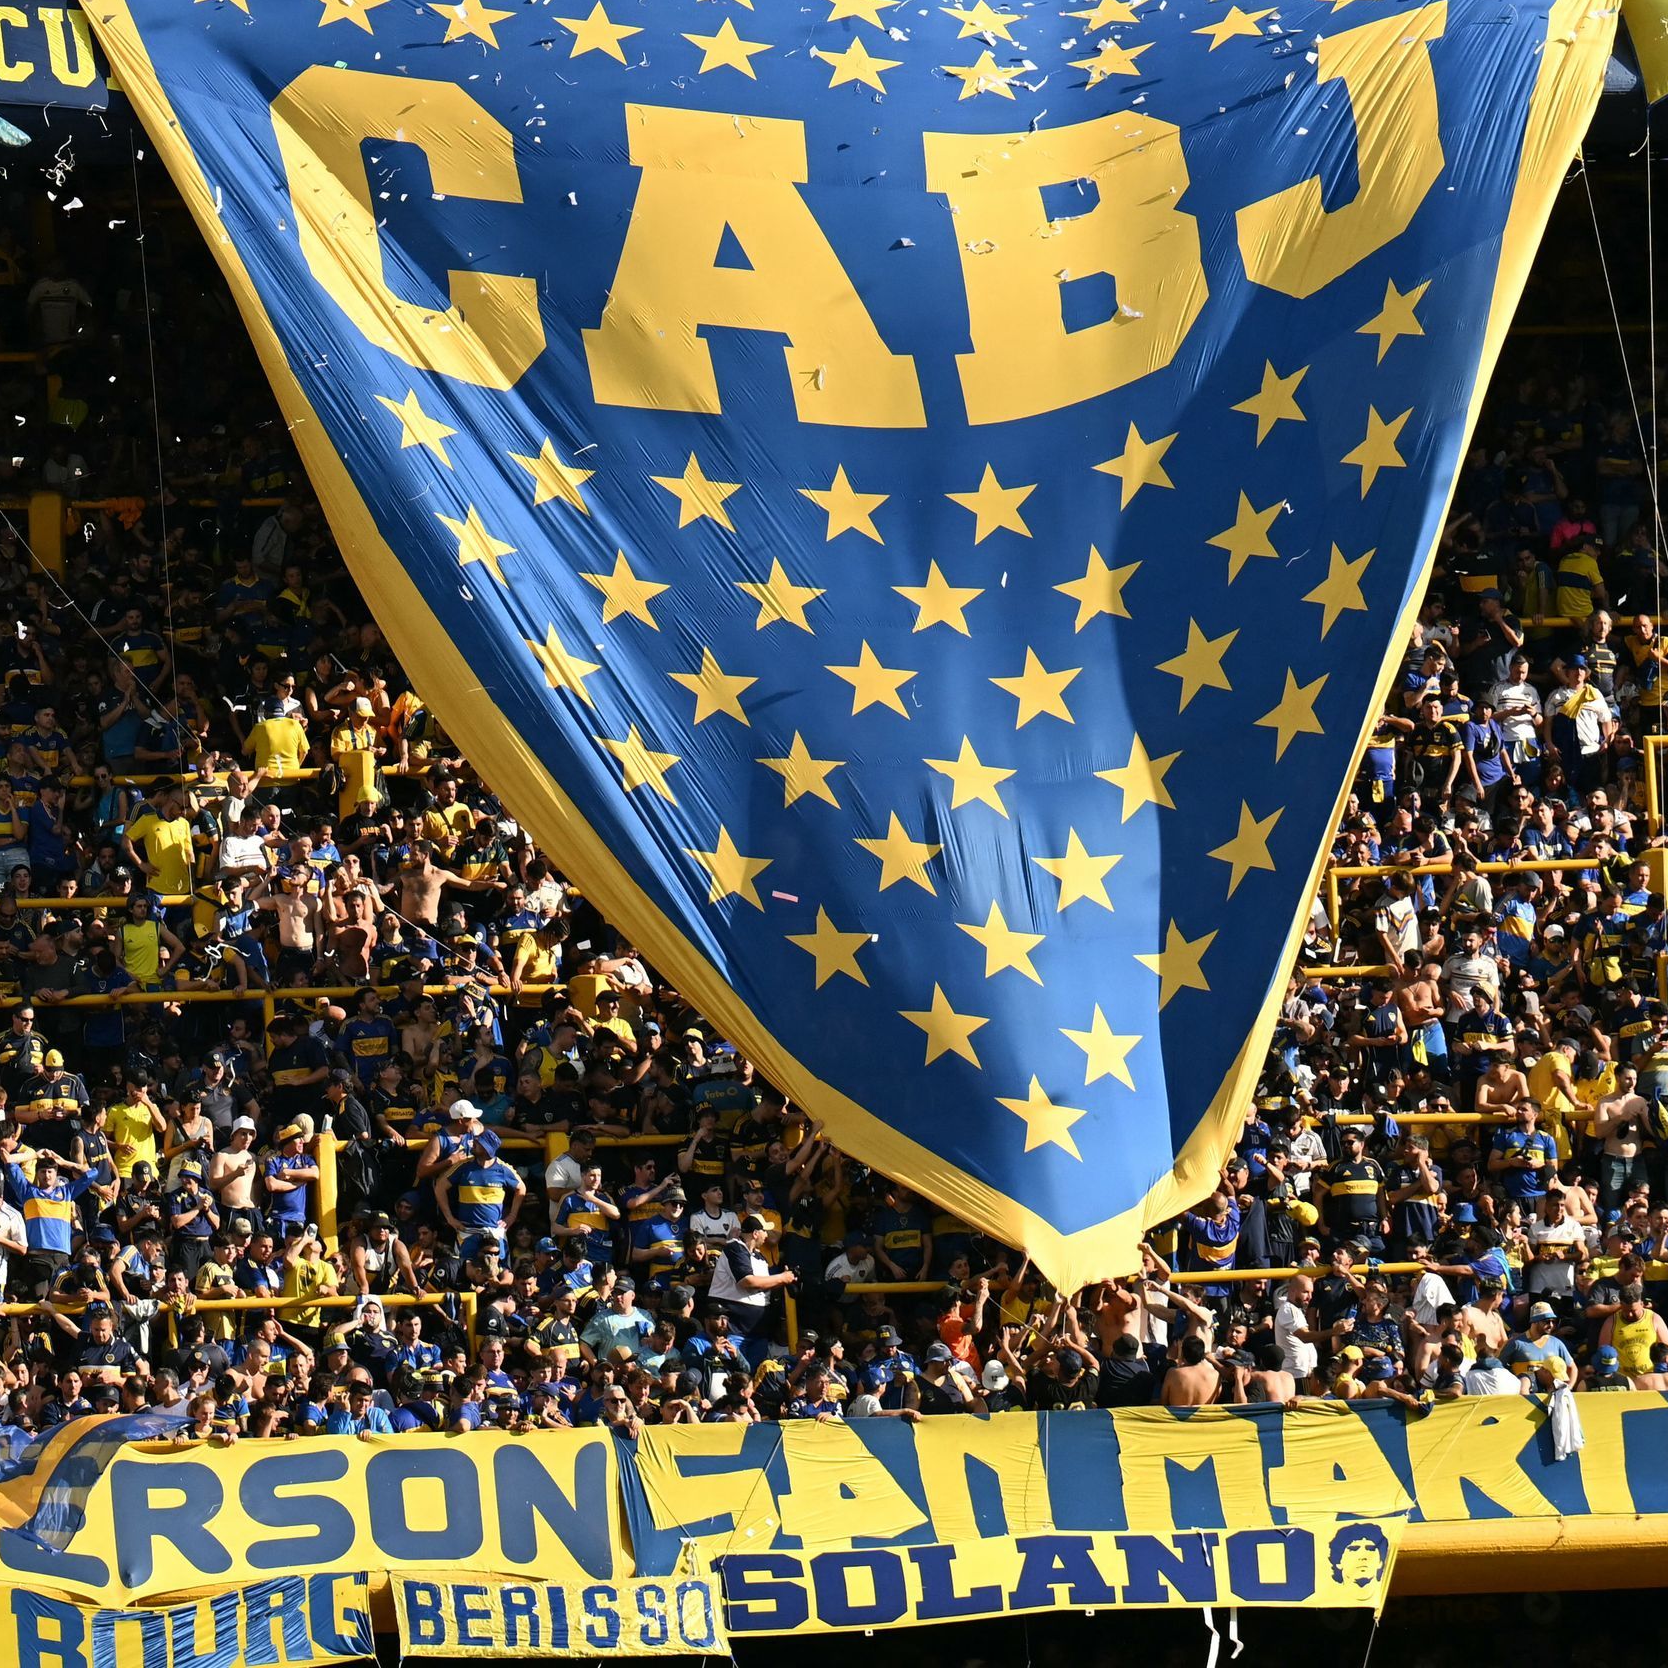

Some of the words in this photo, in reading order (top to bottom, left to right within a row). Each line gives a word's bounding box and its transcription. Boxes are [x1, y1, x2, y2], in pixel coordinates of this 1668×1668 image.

[269, 0, 1448, 429] CABJ
[1250, 1134, 1260, 1144] 10
[12, 1574, 372, 1668] BOURG
[403, 1579, 715, 1649] BERISSO
[710, 1528, 1316, 1632] SOLANO
